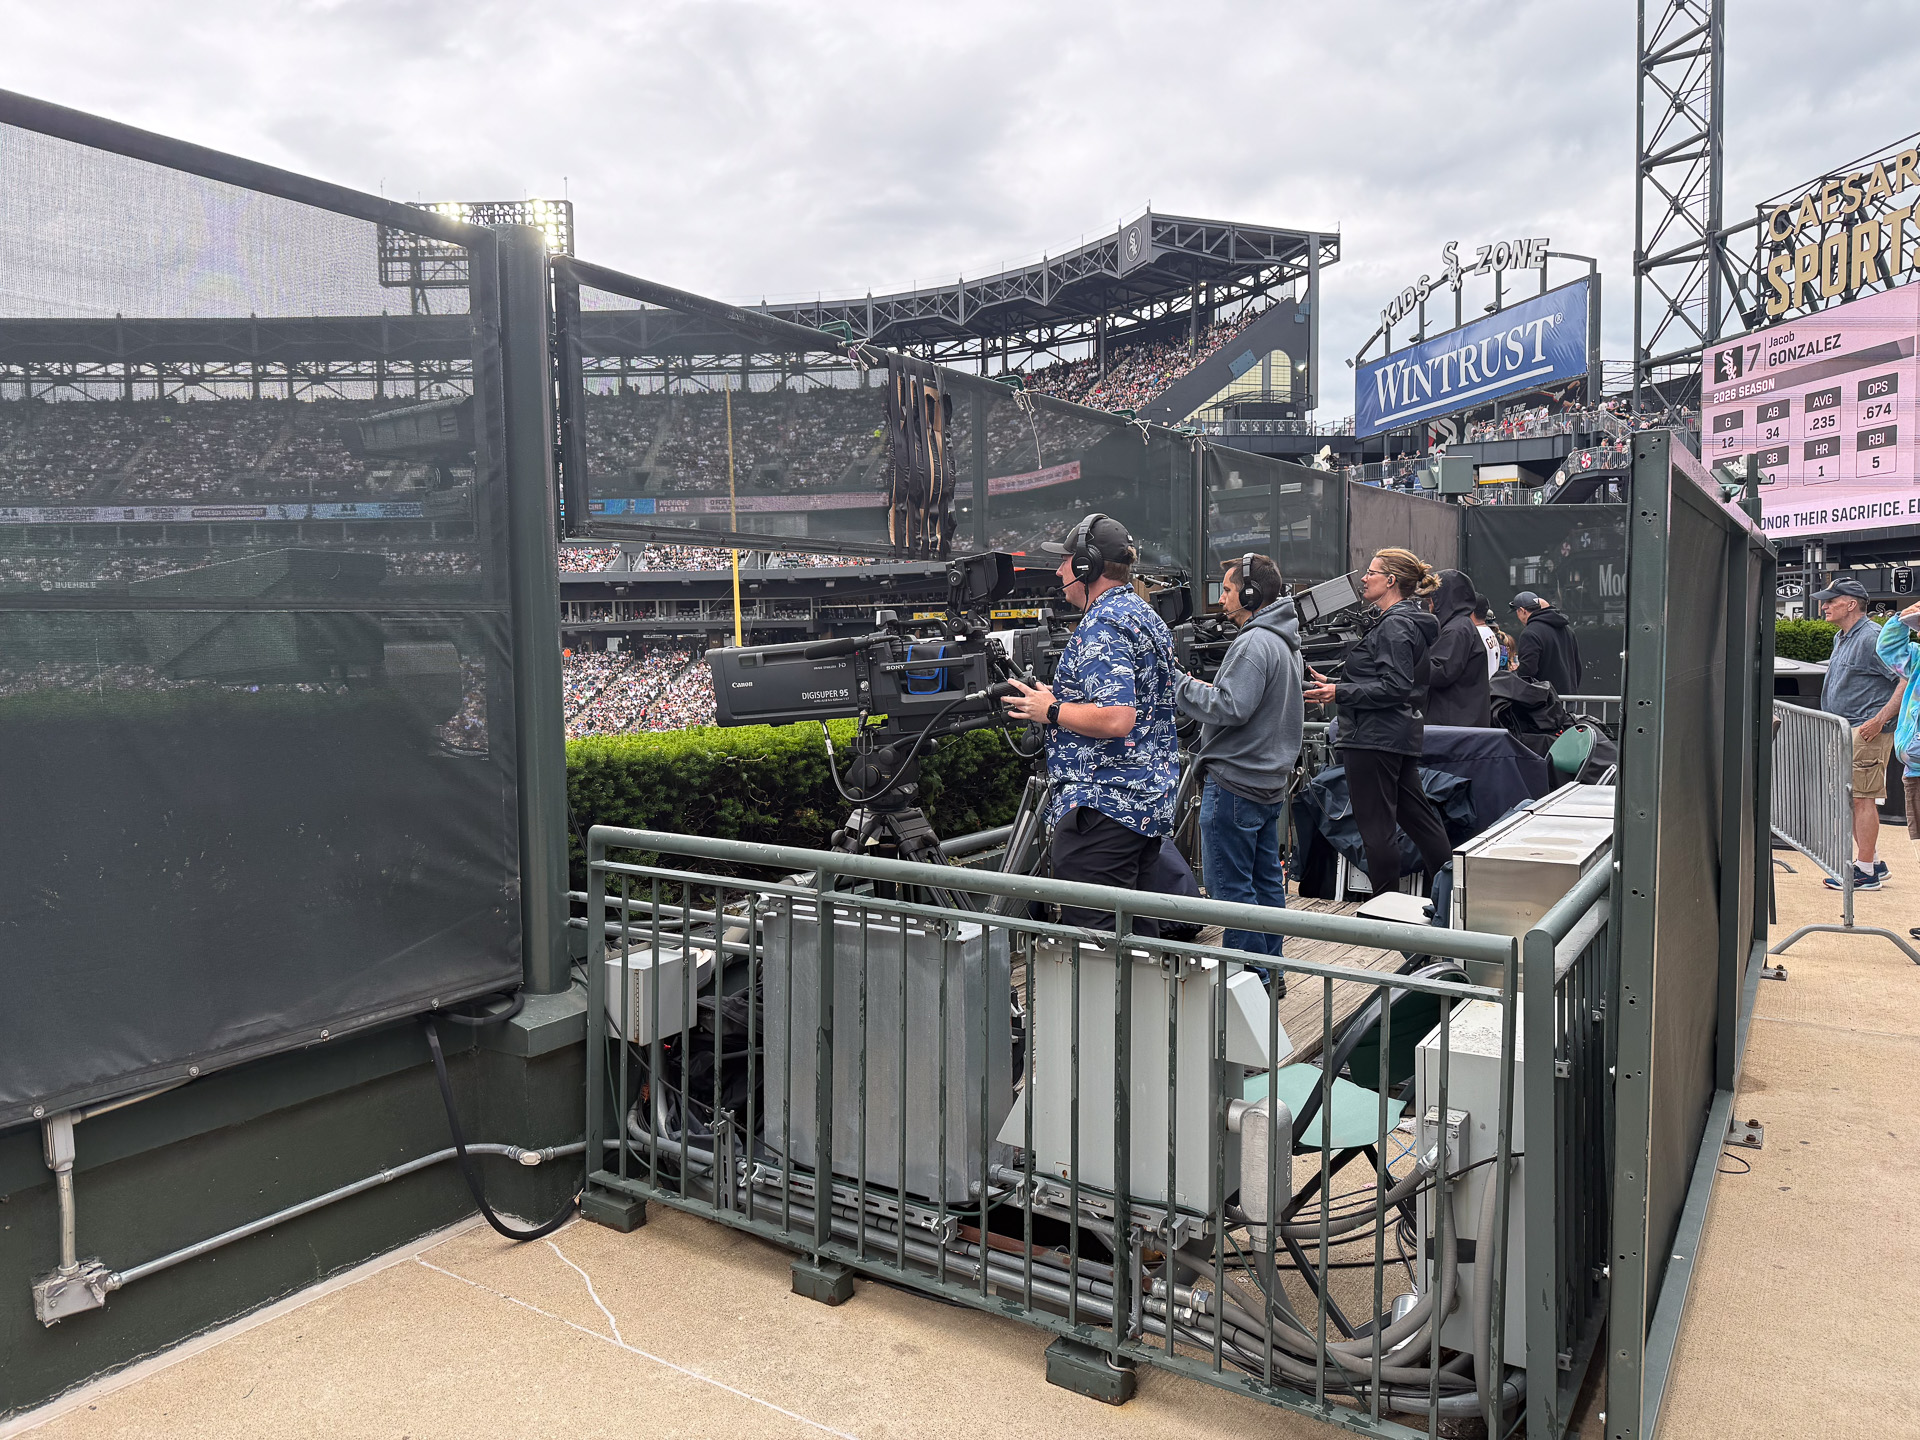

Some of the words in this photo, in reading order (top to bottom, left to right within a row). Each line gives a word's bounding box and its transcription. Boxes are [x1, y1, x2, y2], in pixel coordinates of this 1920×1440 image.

[1380, 274, 1430, 334] KIDS
[1474, 238, 1550, 276] ZONE
[1768, 331, 1795, 348] Jacob
[1746, 342, 1761, 372] 7
[1768, 333, 1842, 367] GONZALEZ
[1713, 388, 1737, 404] 2026
[1738, 377, 1775, 397] SEASON
[1867, 380, 1889, 395] OPS
[1812, 393, 1833, 408] AVG
[1766, 406, 1779, 418] AB
[1862, 403, 1892, 420] .674
[1725, 417, 1731, 428] G
[1809, 415, 1836, 431] .235
[1765, 427, 1780, 440] 34
[1868, 432, 1885, 446] RBI
[1721, 436, 1734, 449] 12
[1815, 443, 1829, 456] HR
[1766, 453, 1778, 465] 3B
[1872, 456, 1880, 468] 5
[1818, 465, 1825, 477] 1
[1793, 510, 1828, 527] THEIR
[1831, 500, 1904, 523] SACRIFICE.
[801, 689, 838, 700] DIGISUPER
[839, 688, 849, 697] 95
